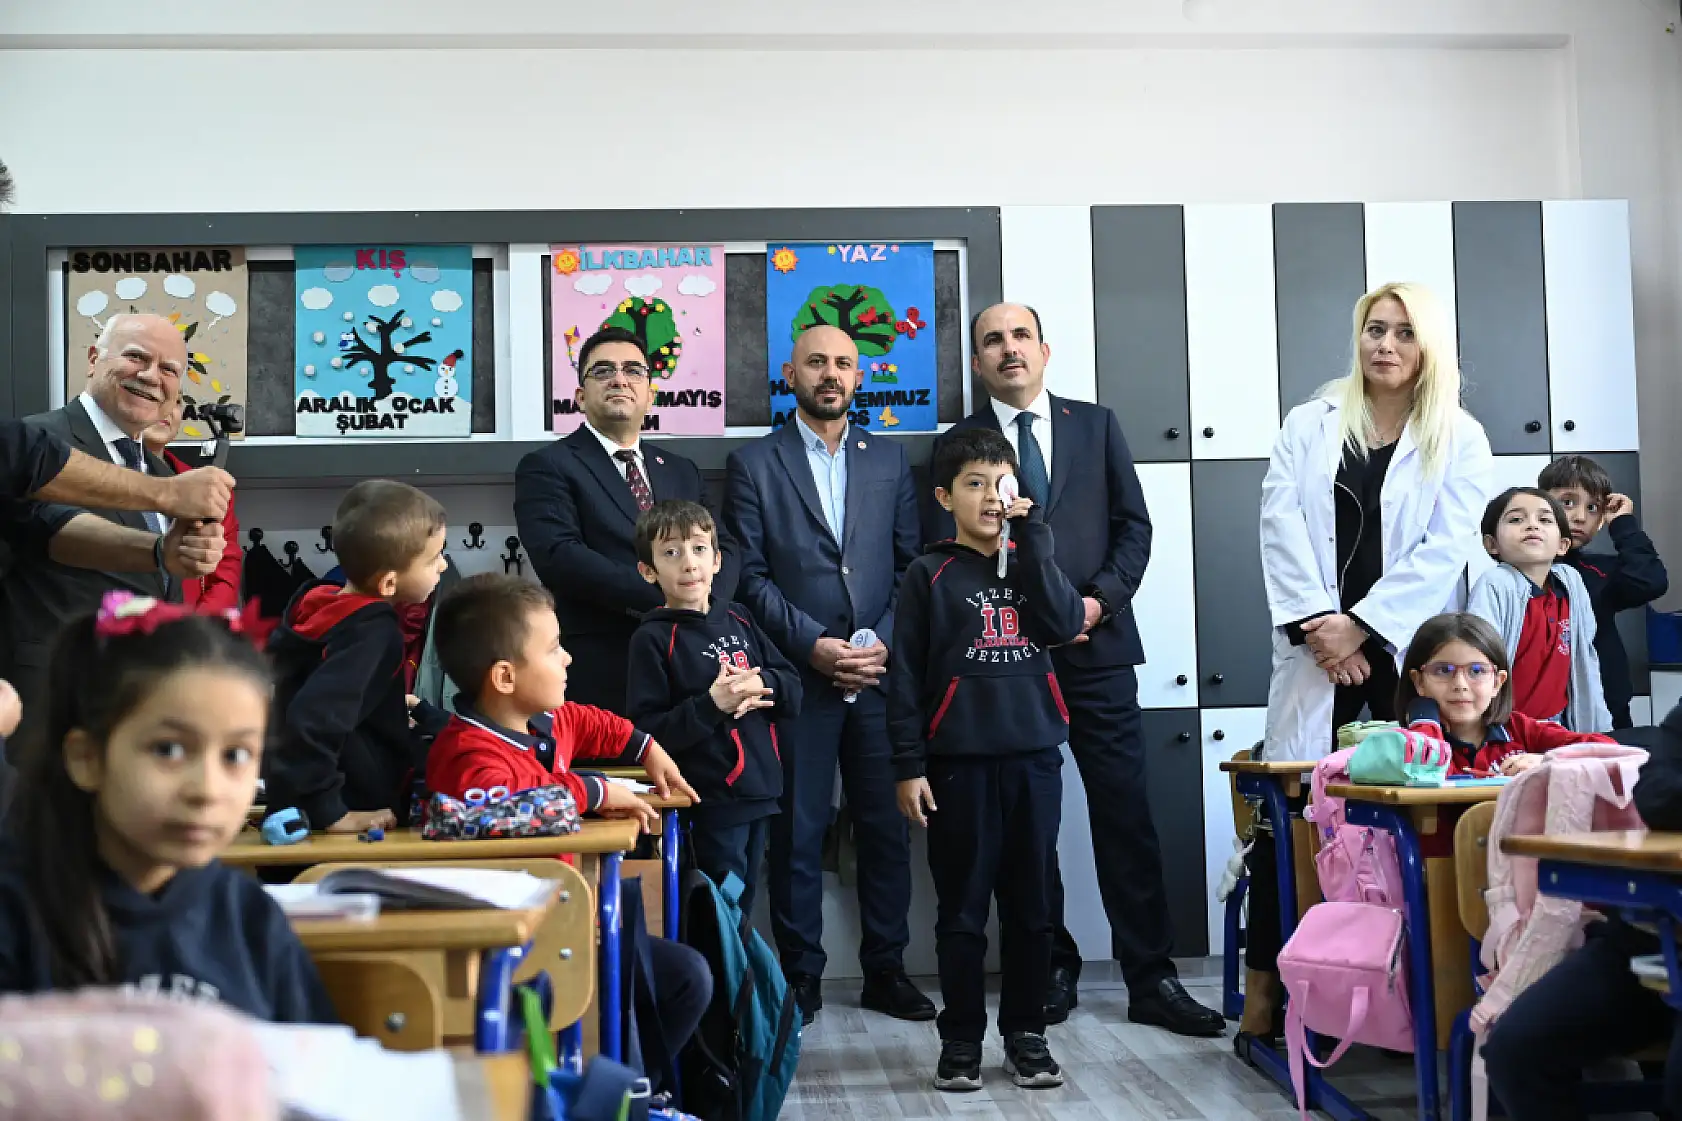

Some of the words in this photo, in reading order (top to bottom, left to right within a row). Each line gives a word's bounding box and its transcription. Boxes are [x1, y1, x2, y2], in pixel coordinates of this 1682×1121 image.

[72, 249, 233, 273] SONBAHAR
[356, 249, 407, 279] KIŞ
[579, 245, 713, 271] İLKBAHAR
[837, 244, 887, 264] YAZ
[296, 396, 377, 413] ARALIK
[392, 396, 455, 413] OCAK
[657, 389, 722, 408] MAYIS
[853, 388, 931, 409] EMMUZ
[336, 413, 409, 435] ŞUBAT
